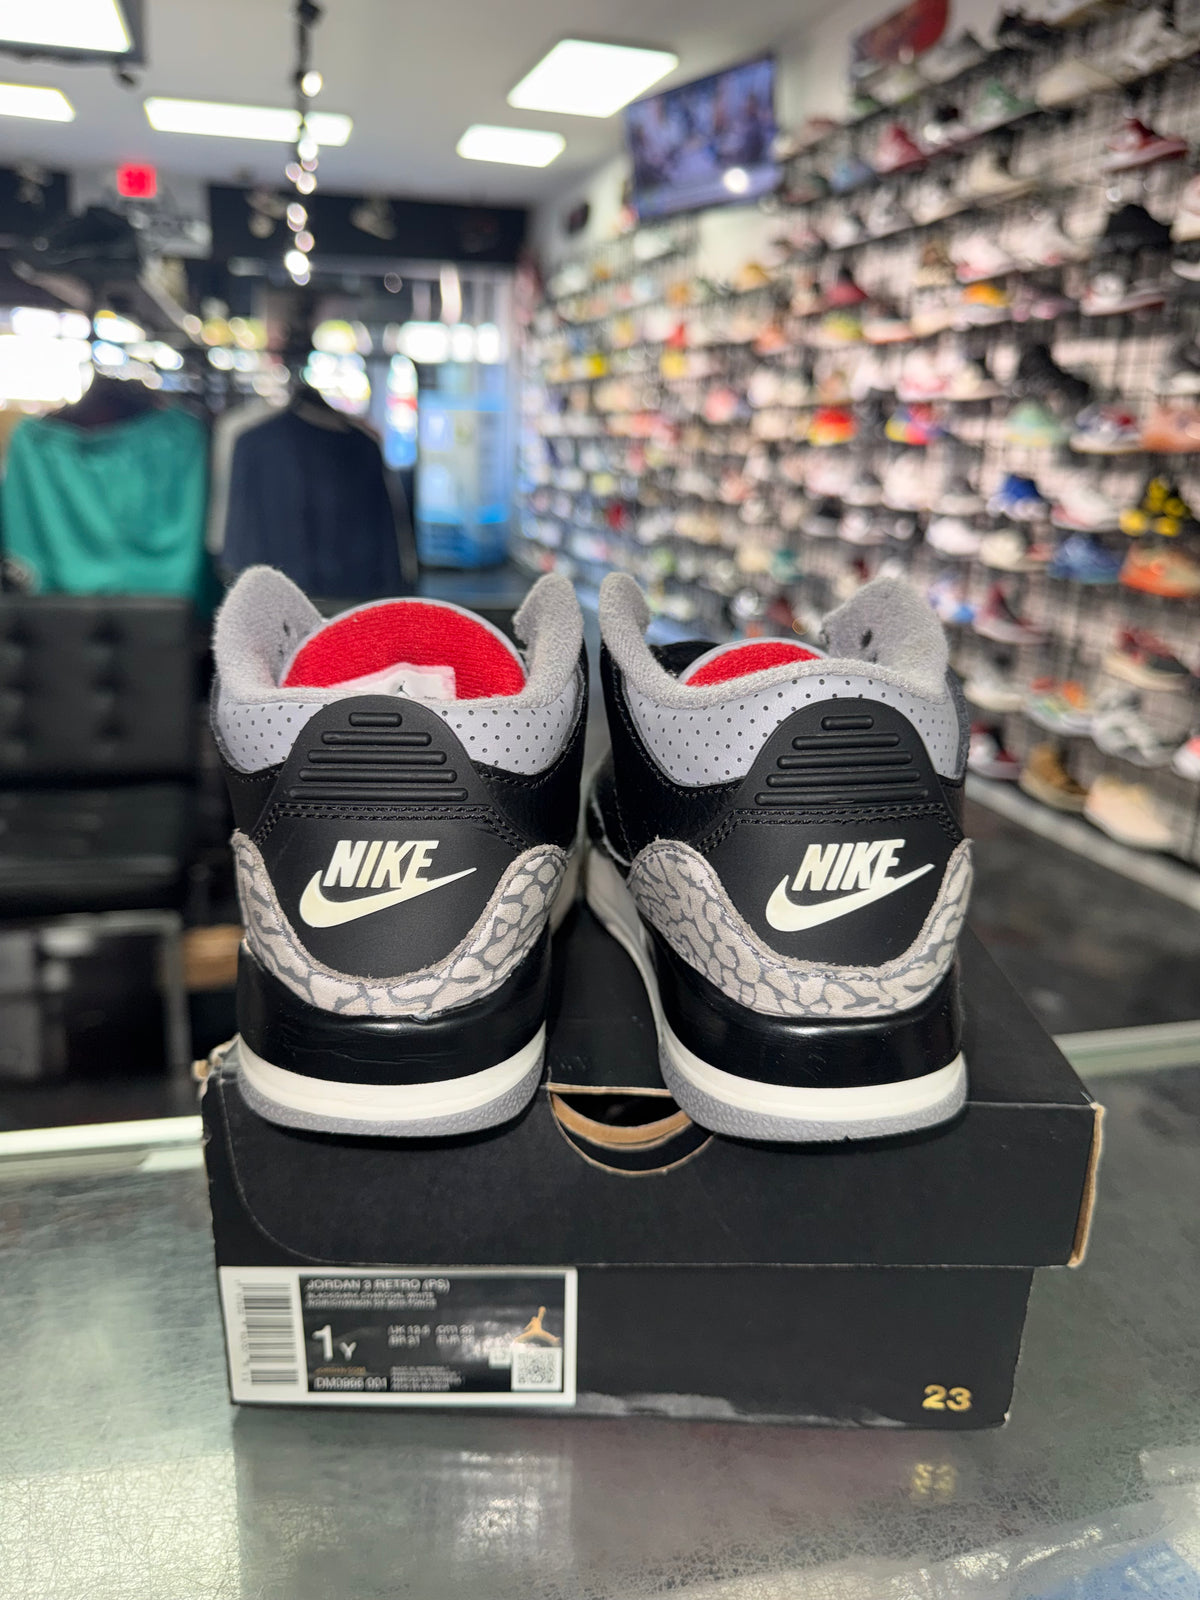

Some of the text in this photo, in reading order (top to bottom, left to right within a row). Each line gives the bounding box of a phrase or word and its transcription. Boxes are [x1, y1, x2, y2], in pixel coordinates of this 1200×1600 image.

[322, 839, 439, 888] NIKE
[791, 838, 906, 891] NIKE
[306, 1279, 450, 1294] JORDAN 3 RETRO (PS)
[921, 1384, 972, 1411] 23
